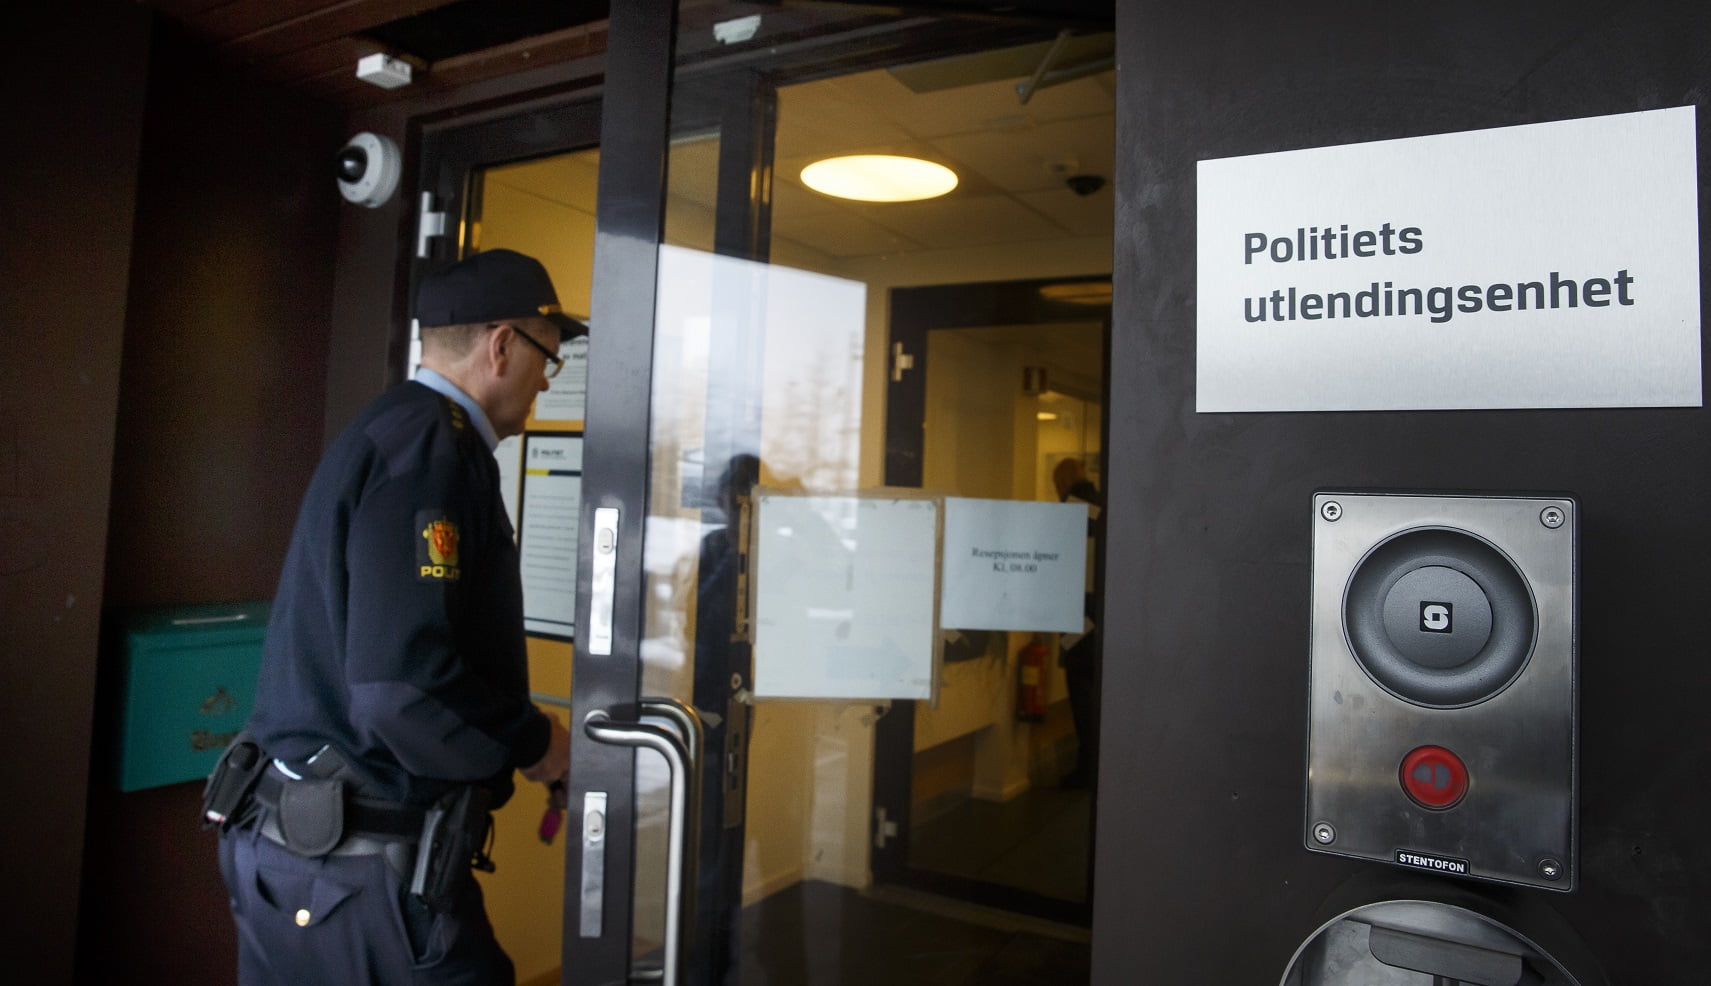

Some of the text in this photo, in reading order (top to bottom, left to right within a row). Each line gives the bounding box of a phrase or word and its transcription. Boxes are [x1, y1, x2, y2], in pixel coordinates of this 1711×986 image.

[1244, 222, 1424, 265] Politiets
[1244, 269, 1635, 323] utlendingsenhet
[1399, 853, 1465, 873] STENTOFON
